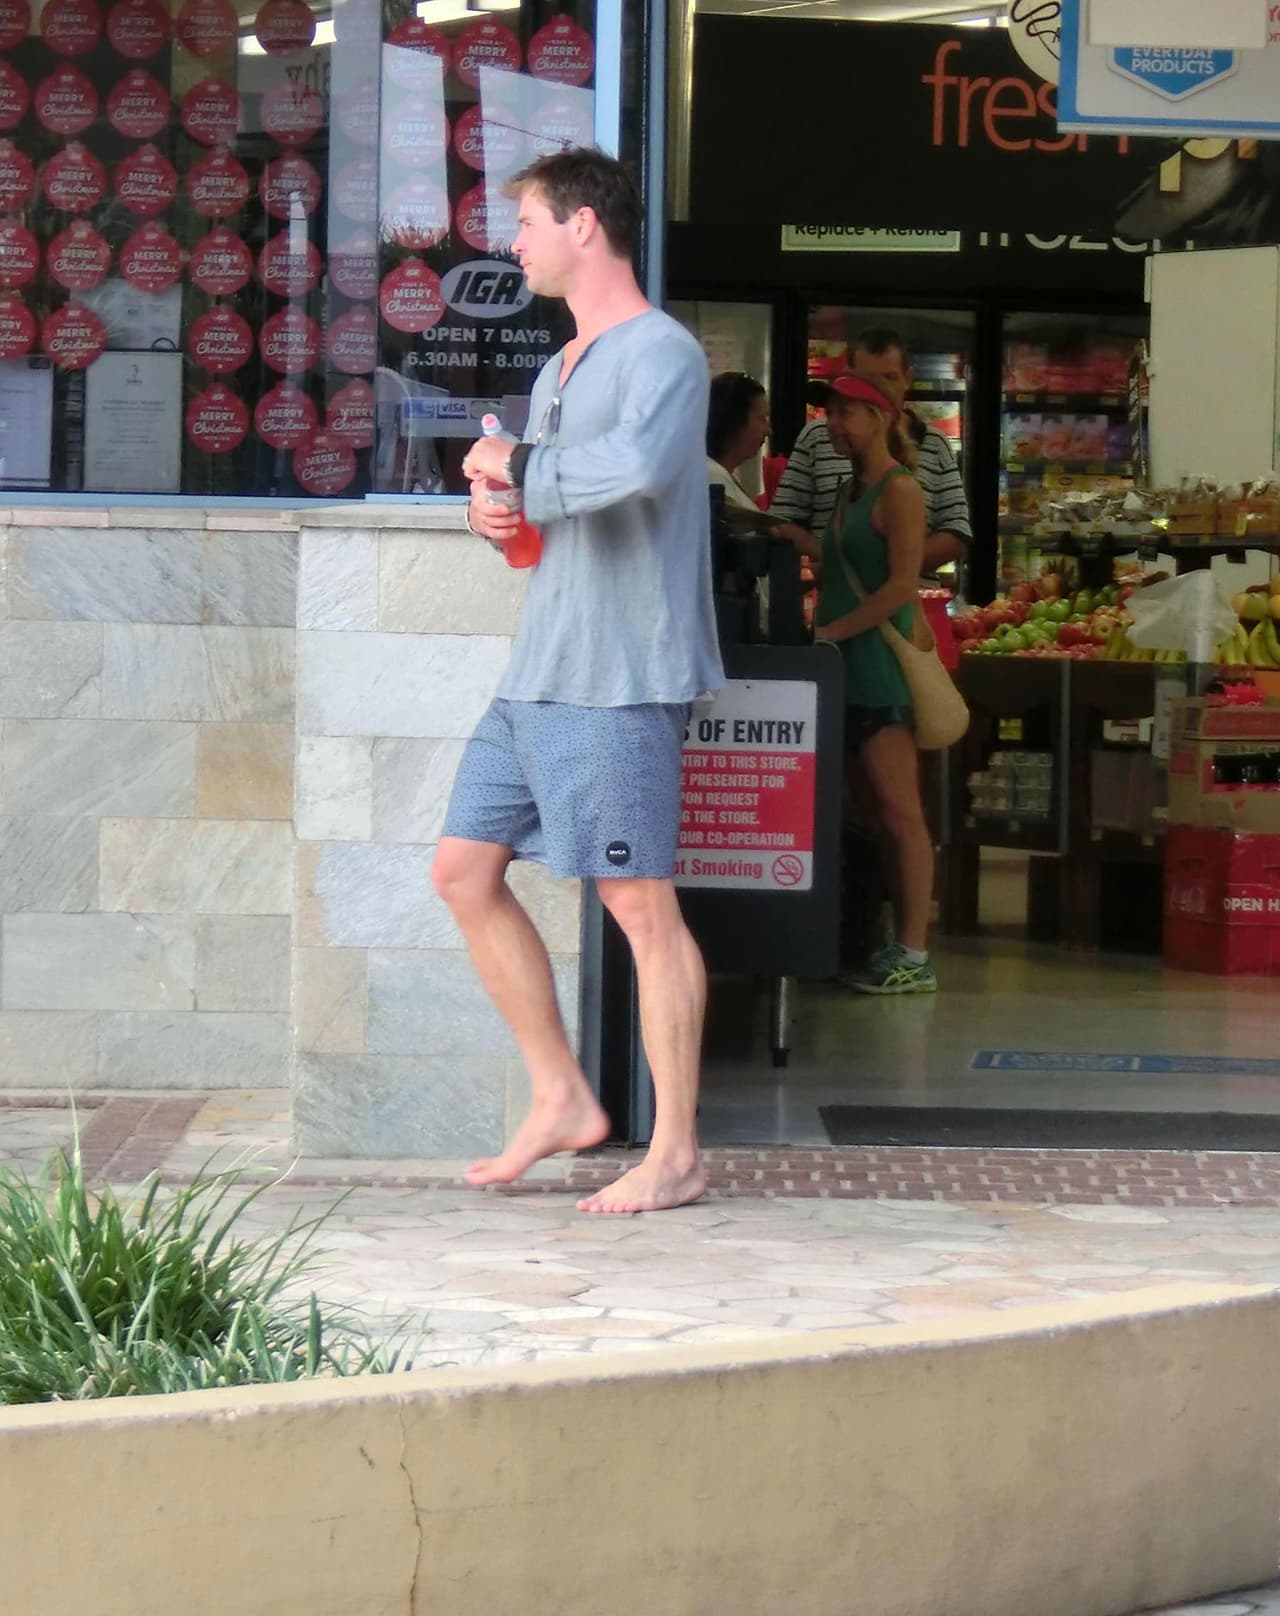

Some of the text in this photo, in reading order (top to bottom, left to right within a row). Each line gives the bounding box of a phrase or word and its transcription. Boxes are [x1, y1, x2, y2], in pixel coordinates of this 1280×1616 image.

[469, 46, 507, 57] MERRY
[543, 46, 581, 57] MERRY
[1132, 48, 1213, 59] EVERYDAY
[535, 57, 590, 71] Christmas
[1131, 58, 1215, 74] PRODUCTS
[49, 93, 84, 102] MERRY
[121, 98, 156, 107] MERRY
[194, 103, 230, 113] MERRY
[188, 112, 242, 125] Christmas
[470, 127, 508, 138] MERRY
[57, 171, 92, 181] MERRY
[128, 172, 163, 183] MERRY
[200, 177, 236, 187] MERRY
[50, 181, 100, 194] Christmas
[120, 182, 171, 197] Christmas
[272, 179, 308, 189] MERRY
[192, 186, 246, 200] Christmas
[471, 207, 509, 217] MERRY
[61, 248, 97, 259] MERRY
[134, 251, 169, 261] MERRY
[203, 253, 239, 264] MERRY
[272, 254, 308, 265] MERRY
[54, 258, 104, 272] Christmas
[127, 260, 177, 274] Christmas
[196, 264, 248, 277] Christmas
[264, 266, 315, 279] Christmas
[393, 288, 432, 299] MERRY
[450, 271, 524, 305] IGA
[386, 299, 440, 313] Christmas
[56, 327, 92, 338] MERRY
[203, 331, 238, 342] MERRY
[272, 332, 308, 342] MERRY
[339, 331, 374, 343] MERRY
[423, 327, 550, 344] OPEN 7 DAYS
[51, 337, 101, 351] Christmas
[196, 342, 247, 355] Christmas
[265, 343, 315, 356] Christmas
[407, 351, 477, 367] 6.30AM
[495, 353, 549, 369] 8.00P
[268, 407, 304, 418] MERRY
[339, 407, 374, 418] MERRY
[440, 402, 466, 413] VISA
[200, 411, 235, 422] MERRY
[192, 421, 243, 435] Christmas
[262, 418, 311, 432] Christmas
[306, 451, 341, 466] MERRY
[302, 463, 351, 481] Christmas
[699, 719, 726, 742] OF
[733, 720, 806, 744] ENTRY
[682, 755, 708, 767] NTRY
[712, 756, 726, 768] TO
[730, 756, 756, 769] THIS
[690, 773, 758, 787] PRESENTED
[762, 775, 785, 788] FOR
[706, 792, 760, 806] REQUEST
[694, 810, 716, 823] THE
[719, 811, 760, 825] STORE.
[680, 831, 795, 847] OUR CO-OPERATION
[691, 859, 763, 879] Smoking
[1224, 897, 1263, 912] OPEN
